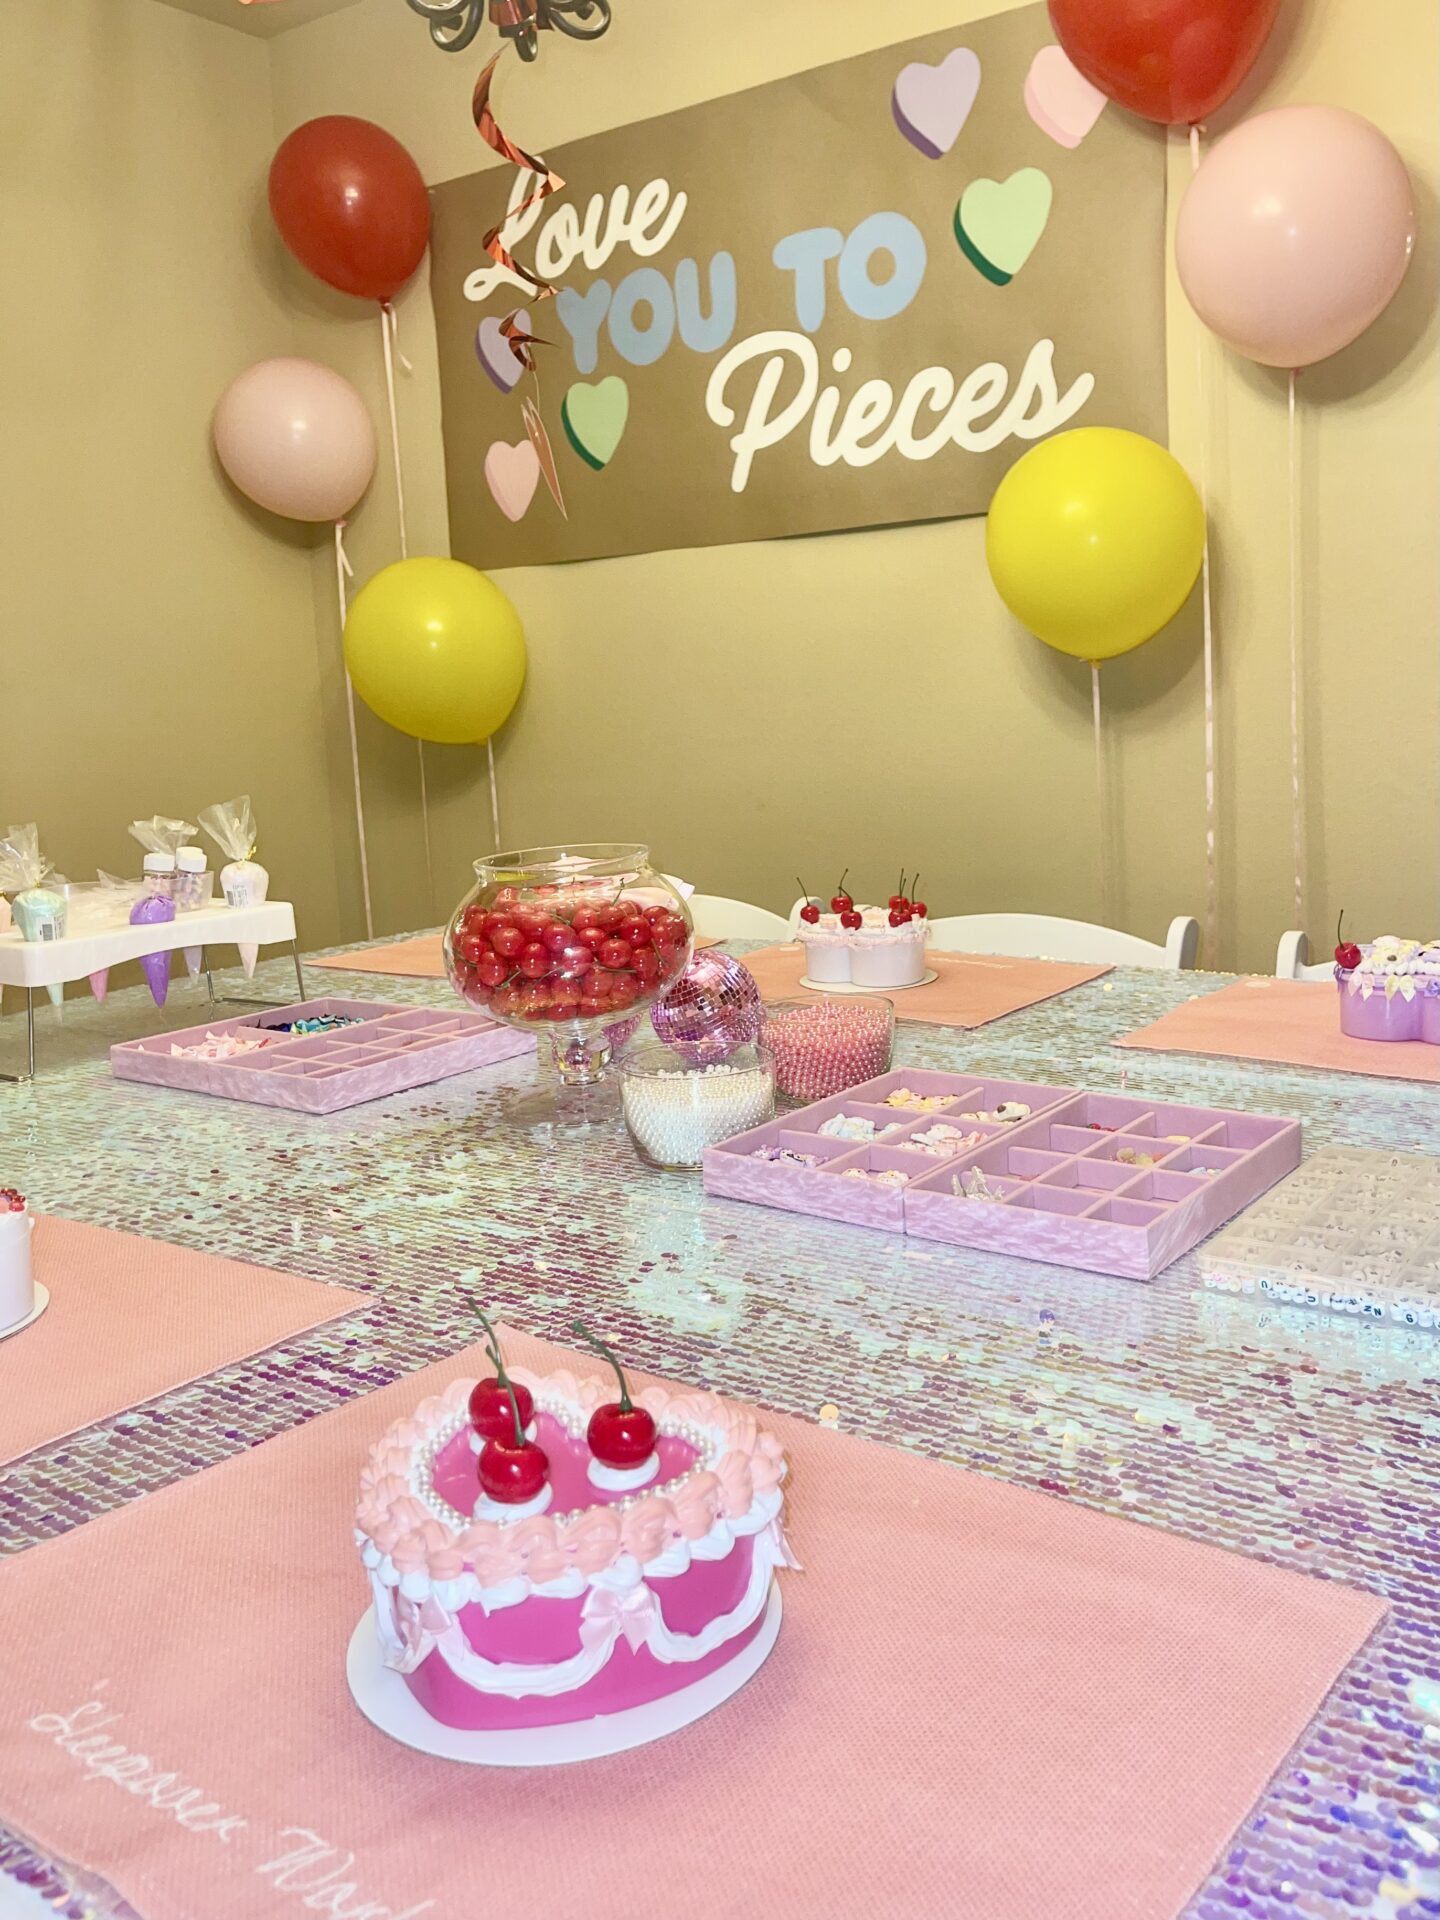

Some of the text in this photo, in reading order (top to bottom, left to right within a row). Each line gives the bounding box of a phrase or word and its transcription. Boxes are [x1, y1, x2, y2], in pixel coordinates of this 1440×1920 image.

[463, 156, 688, 302] Love
[555, 212, 926, 374] YOU TO
[706, 331, 1096, 493] Pieces
